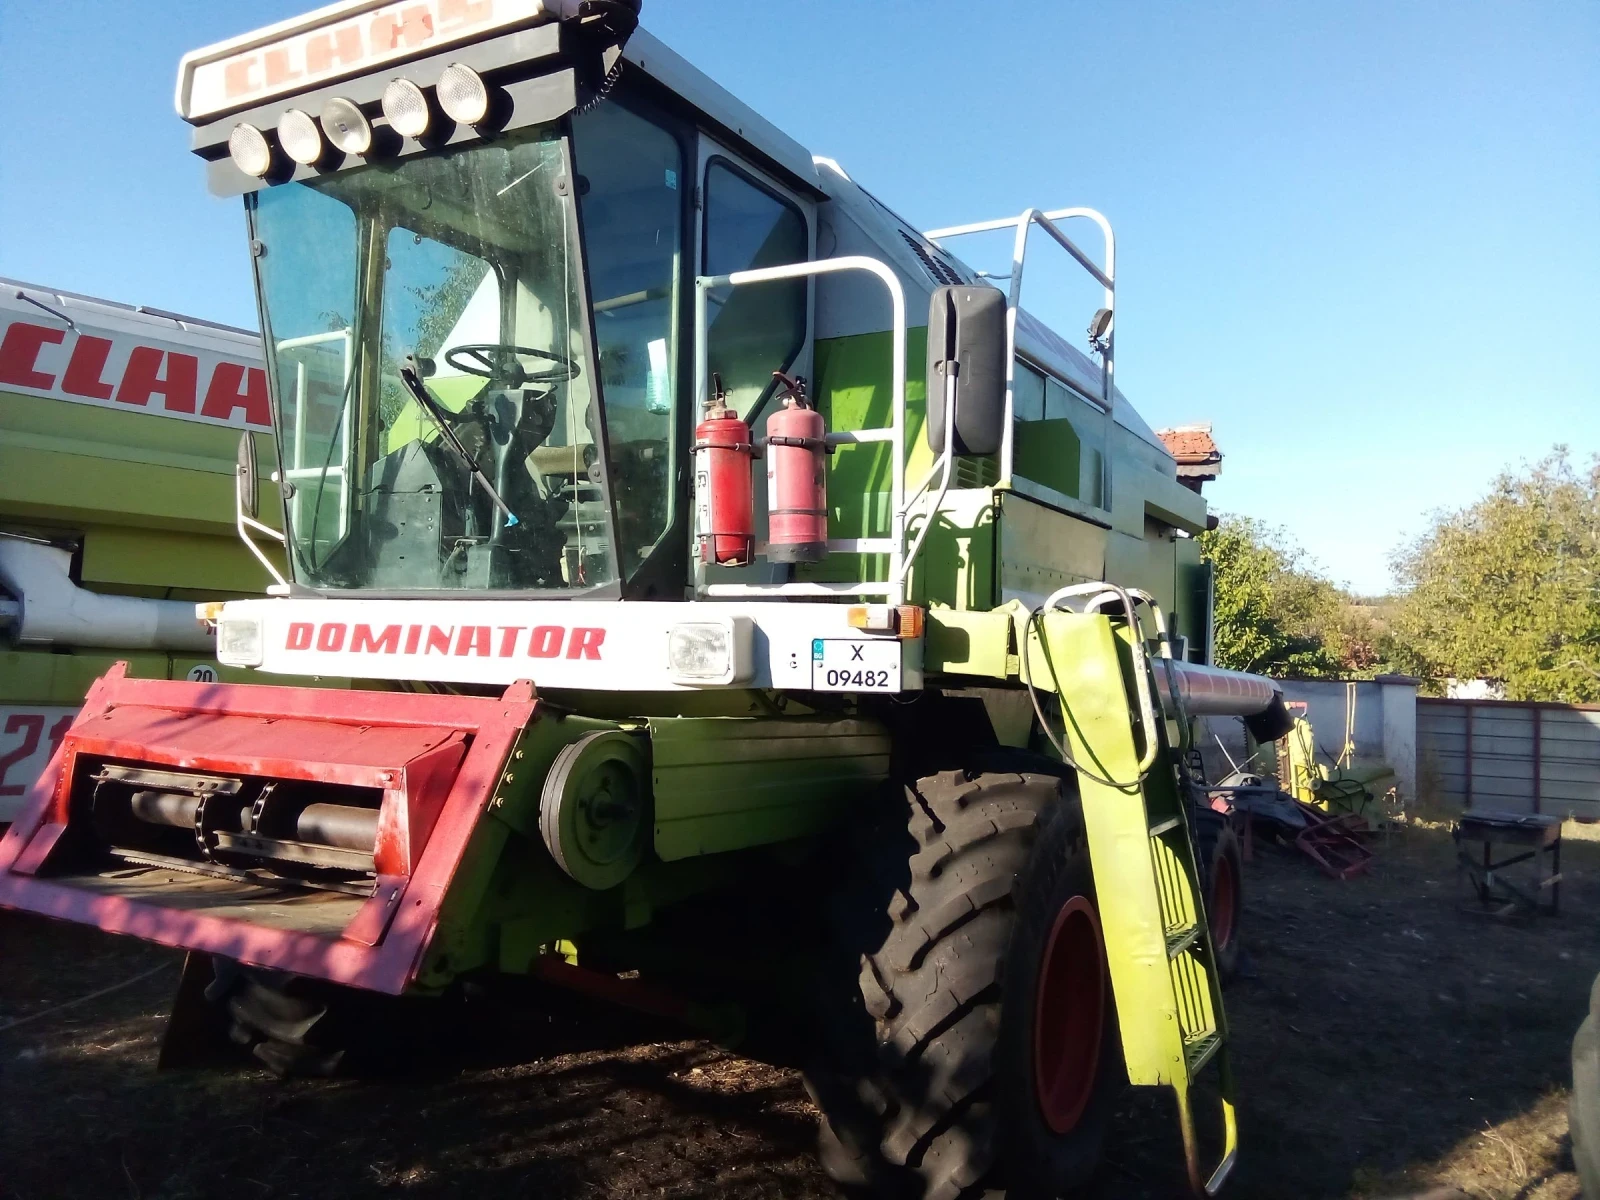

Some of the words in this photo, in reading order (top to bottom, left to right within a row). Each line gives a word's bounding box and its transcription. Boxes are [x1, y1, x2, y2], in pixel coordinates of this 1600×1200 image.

[285, 622, 606, 660] DOMINATOR
[850, 644, 864, 661] X
[827, 669, 889, 687] 09482
